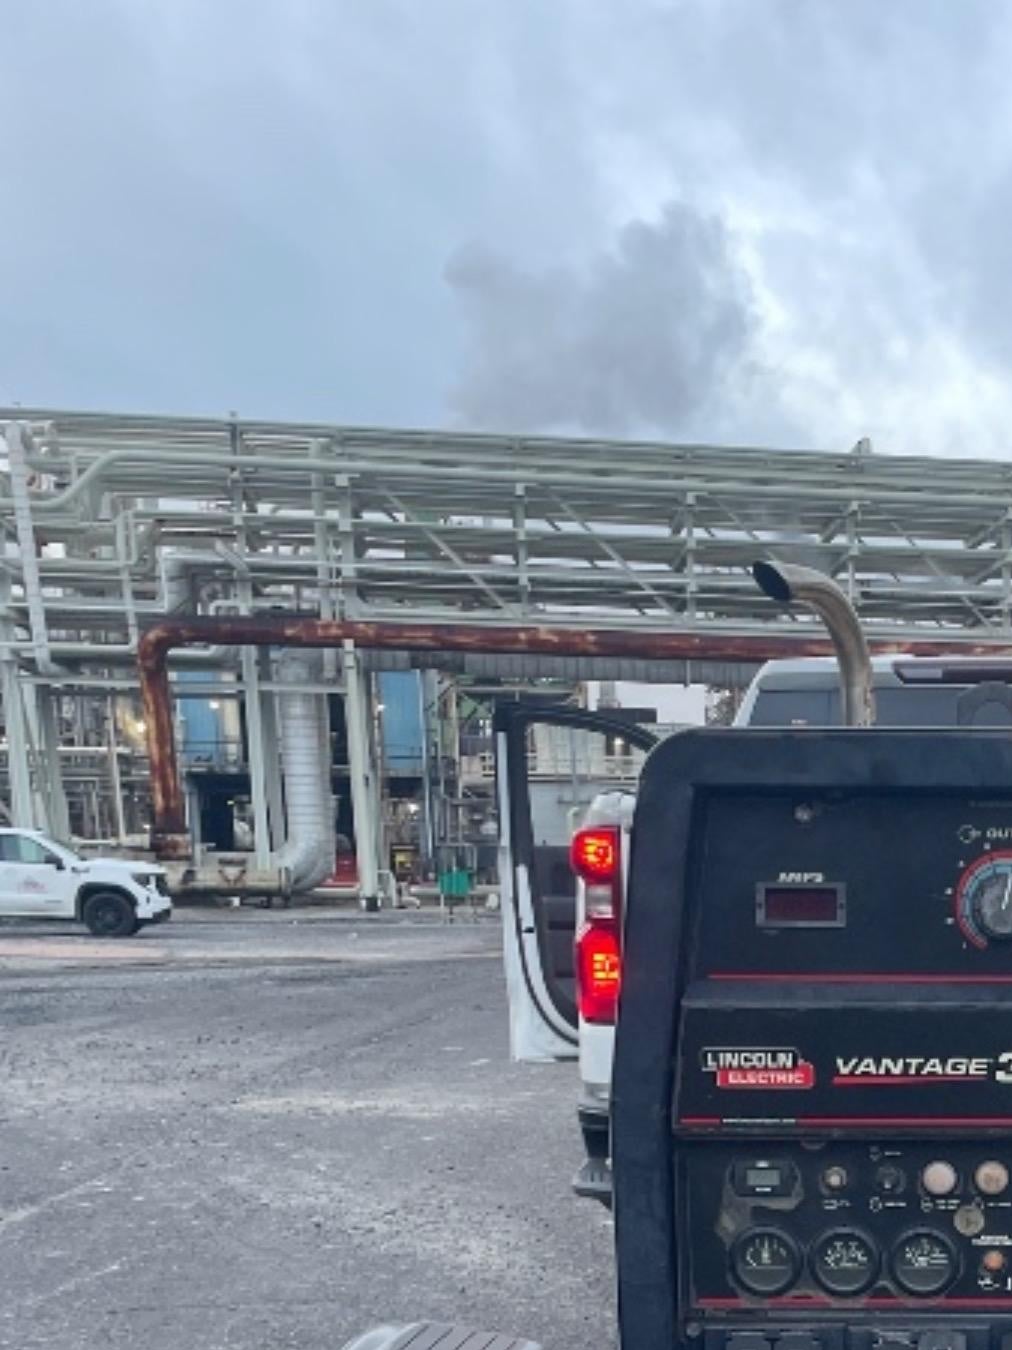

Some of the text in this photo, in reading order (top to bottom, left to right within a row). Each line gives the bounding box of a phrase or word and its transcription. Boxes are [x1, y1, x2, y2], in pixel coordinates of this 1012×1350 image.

[706, 1052, 794, 1069] LINCOLN
[835, 1057, 990, 1076] VANTAGE
[727, 1070, 805, 1085] ELECTRIC
